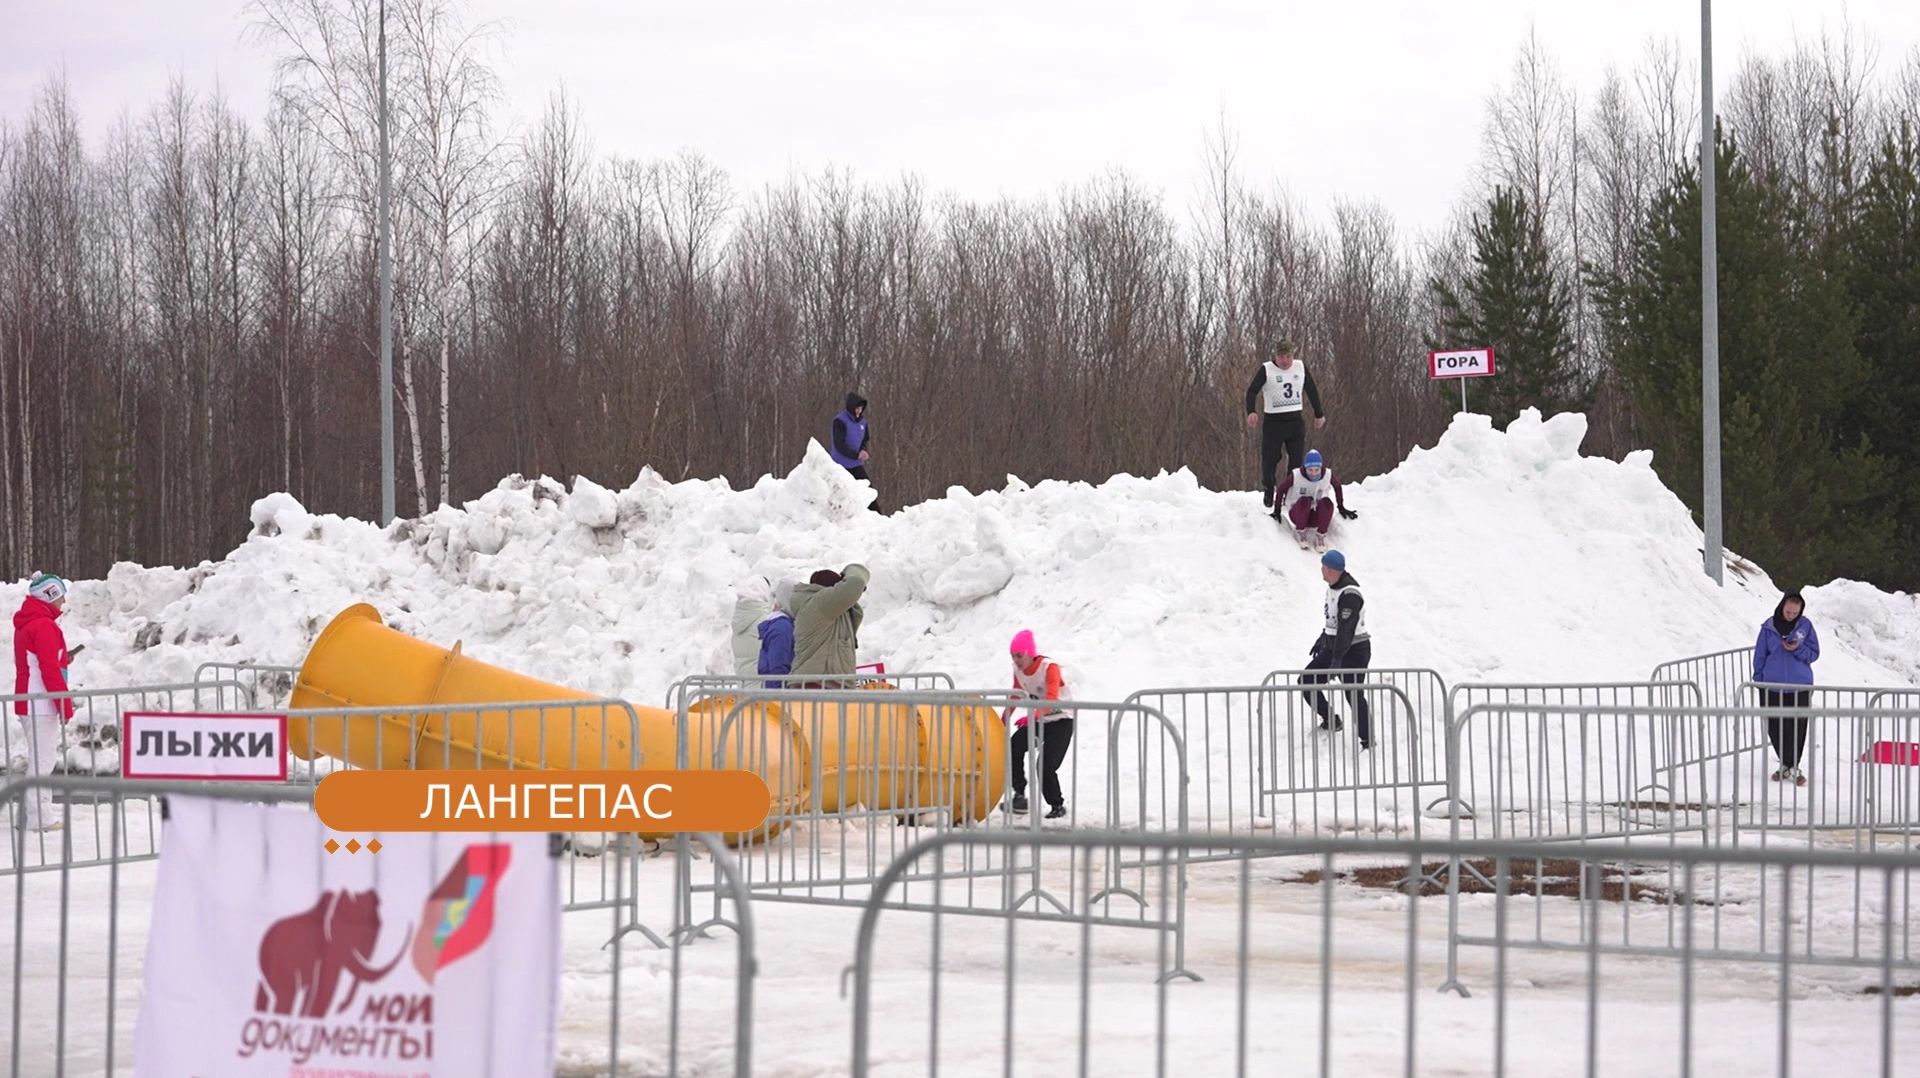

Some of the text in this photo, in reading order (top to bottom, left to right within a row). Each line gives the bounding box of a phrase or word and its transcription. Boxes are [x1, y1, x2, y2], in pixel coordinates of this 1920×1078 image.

[1437, 356, 1479, 369] ГОРА
[1283, 382, 1293, 399] 3
[136, 730, 274, 758] ЛЫЖИ
